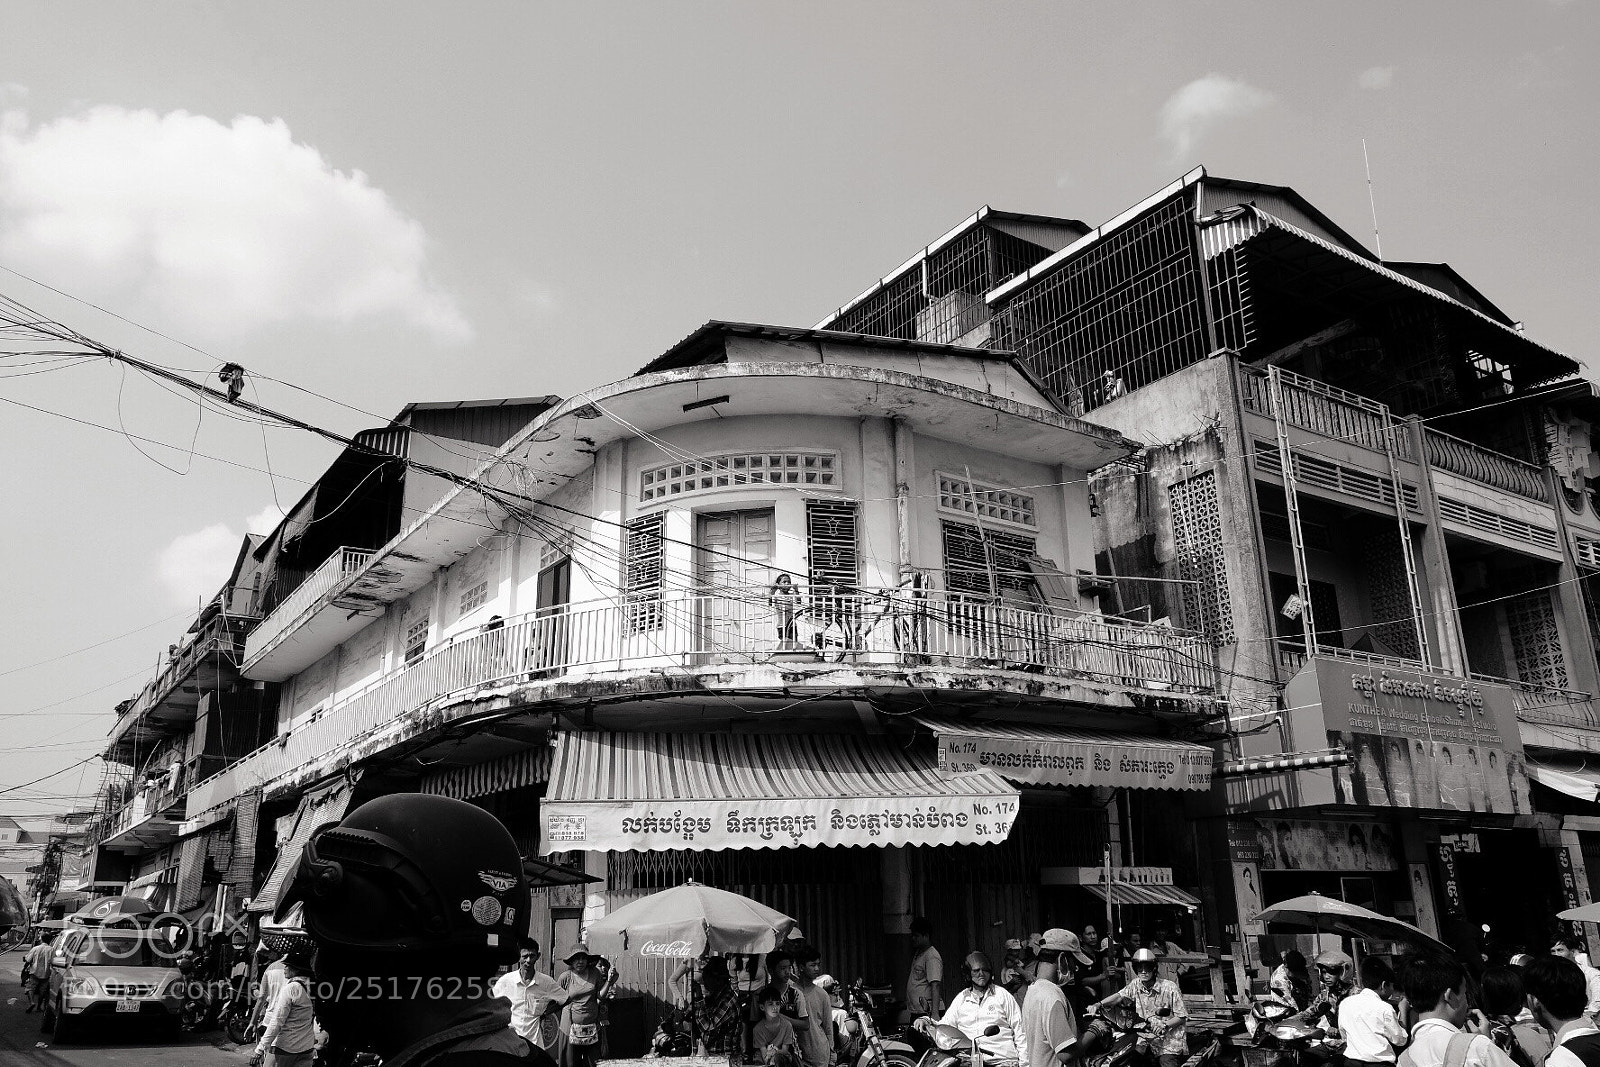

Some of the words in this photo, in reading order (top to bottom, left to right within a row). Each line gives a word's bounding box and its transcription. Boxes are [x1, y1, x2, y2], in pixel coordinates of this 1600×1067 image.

[1347, 702, 1387, 716] KUNTHEA
[1387, 708, 1419, 723] Wedding
[963, 742, 977, 754] 174
[1094, 752, 1112, 771] និង
[973, 803, 992, 815] No.
[975, 823, 991, 836] St.
